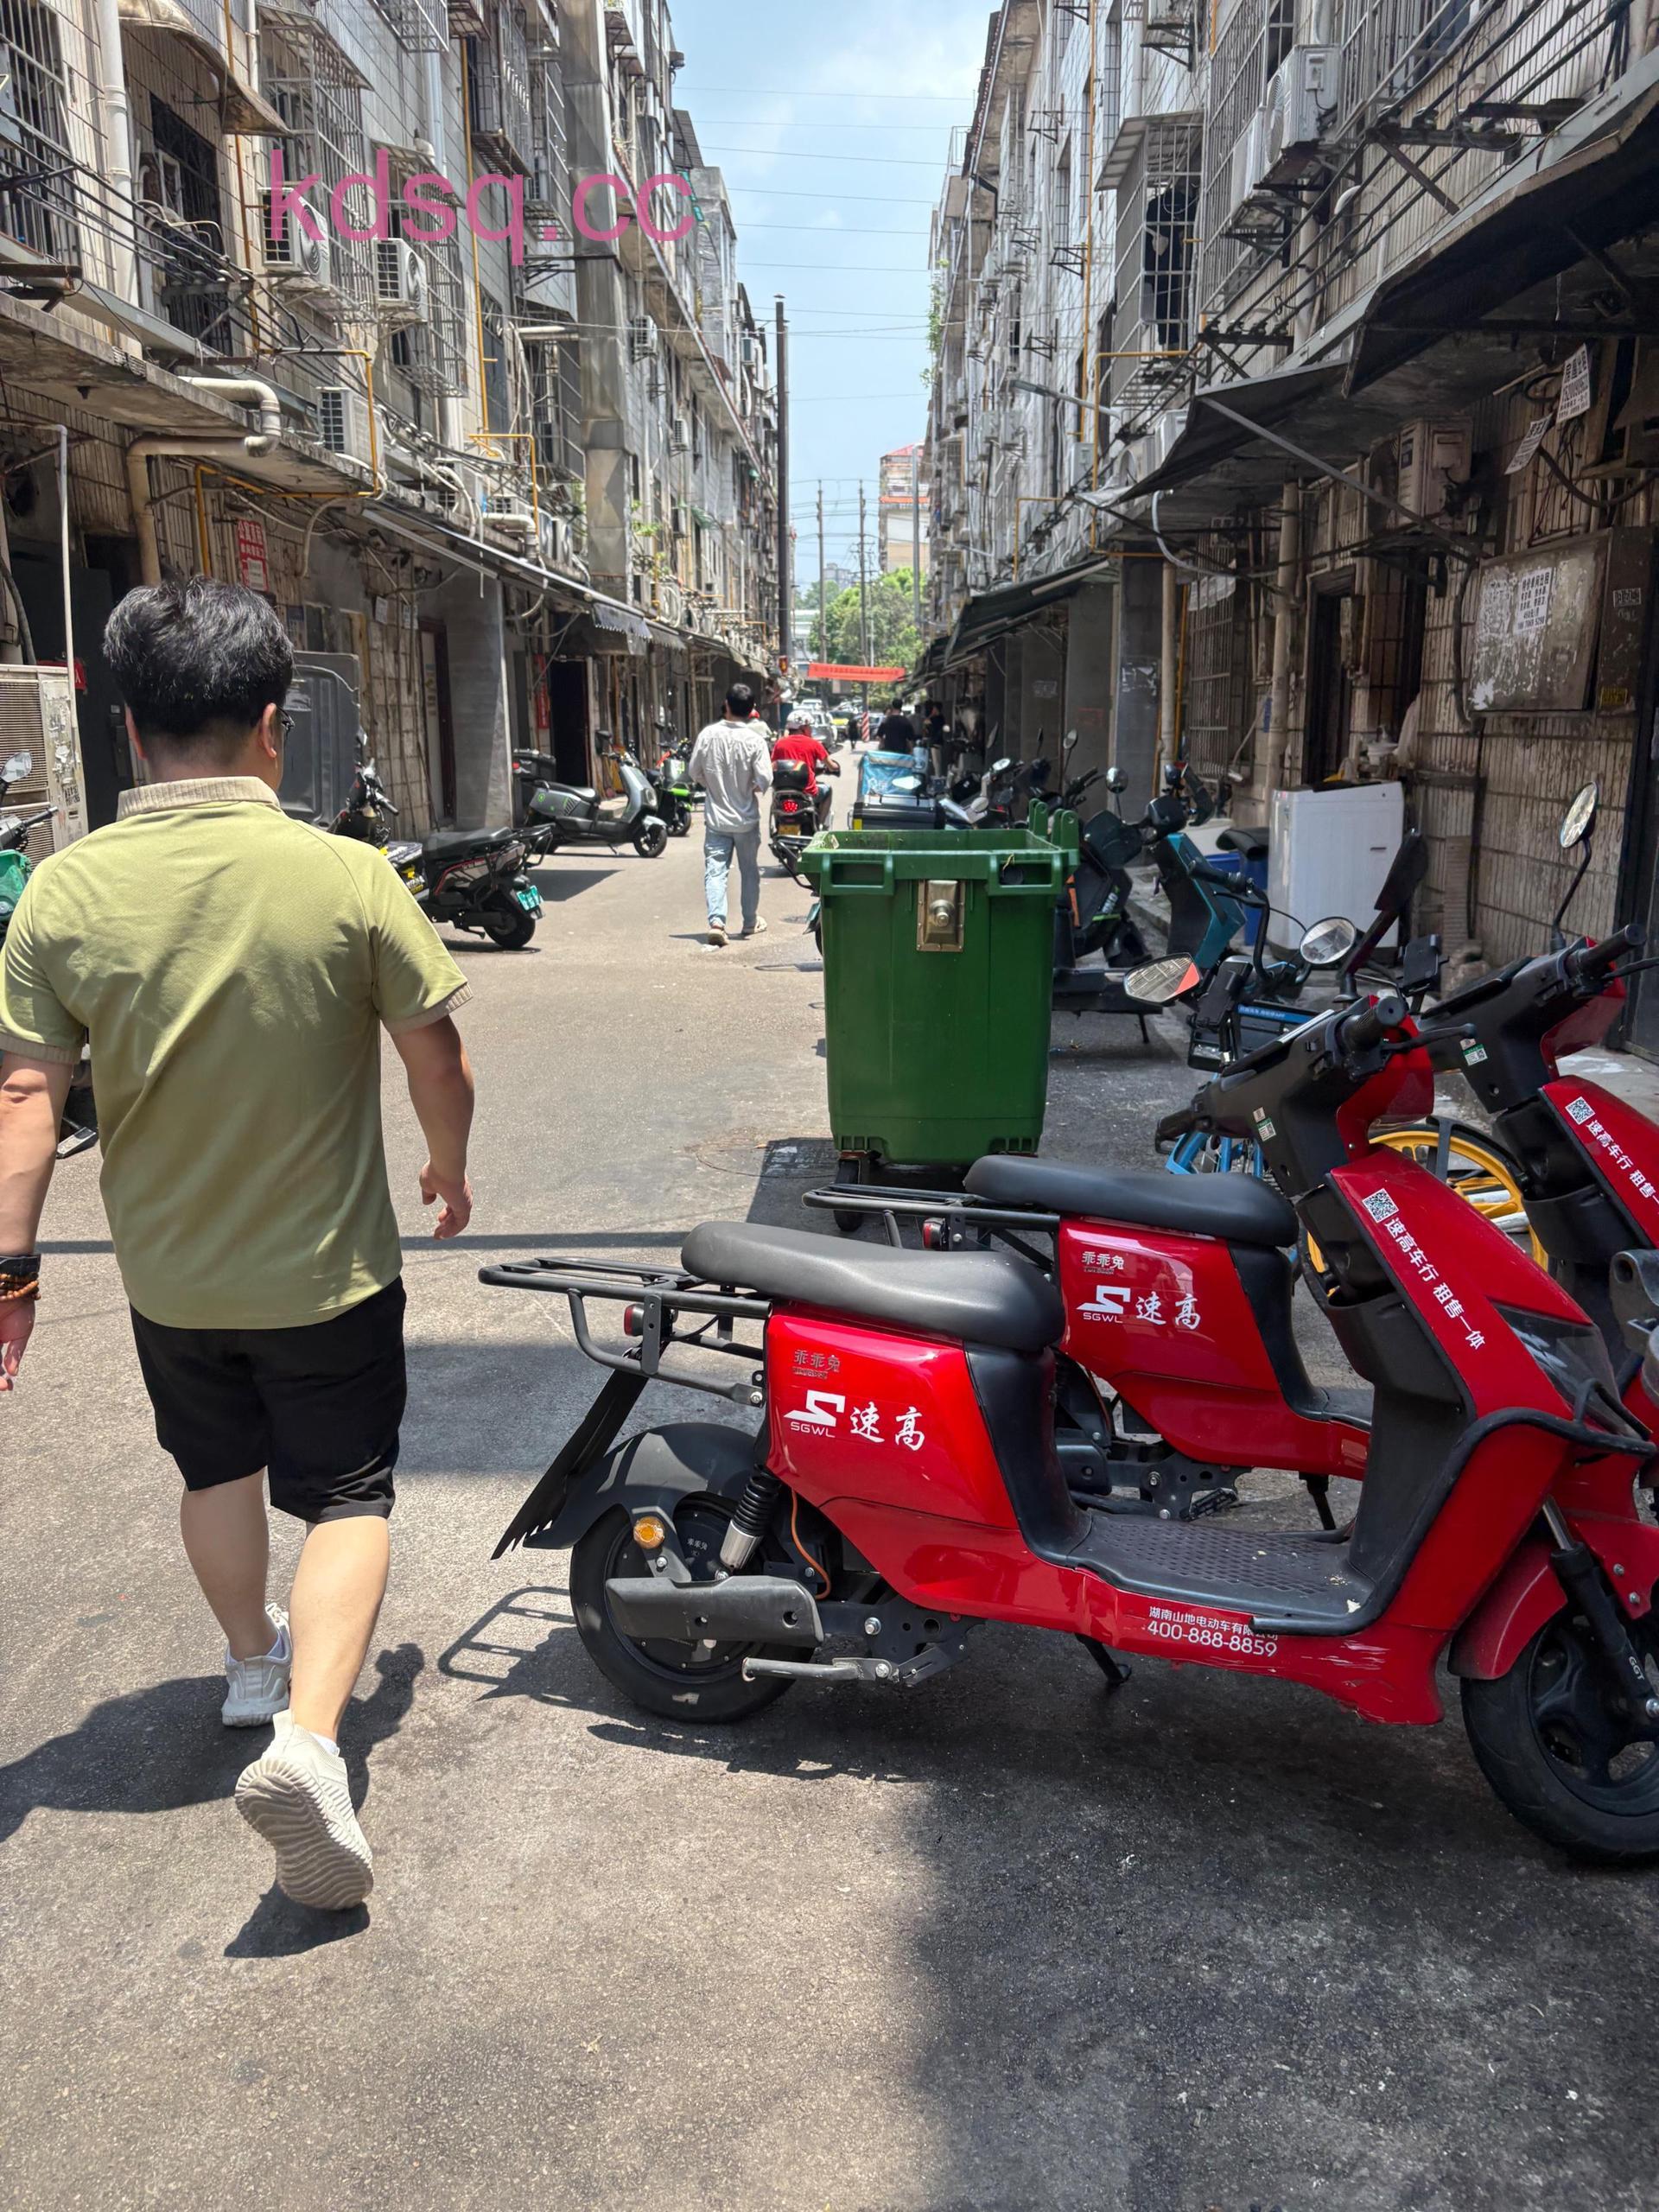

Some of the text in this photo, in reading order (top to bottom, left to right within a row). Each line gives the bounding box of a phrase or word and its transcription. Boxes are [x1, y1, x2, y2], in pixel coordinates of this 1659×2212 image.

[1586, 1120, 1634, 1170] 速高车行
[1081, 1251, 1125, 1270] 乖乖兔
[1384, 1218, 1485, 1350] 速高车行 租售一体
[1083, 1312, 1123, 1324] SGWL
[1135, 1291, 1202, 1330] 速高
[794, 1349, 842, 1373] 乖乖兔
[790, 1421, 836, 1439] SGWL
[850, 1401, 925, 1452] 速高
[1147, 1620, 1278, 1657] 400-888-8859
[1629, 1656, 1645, 1681] GGT
